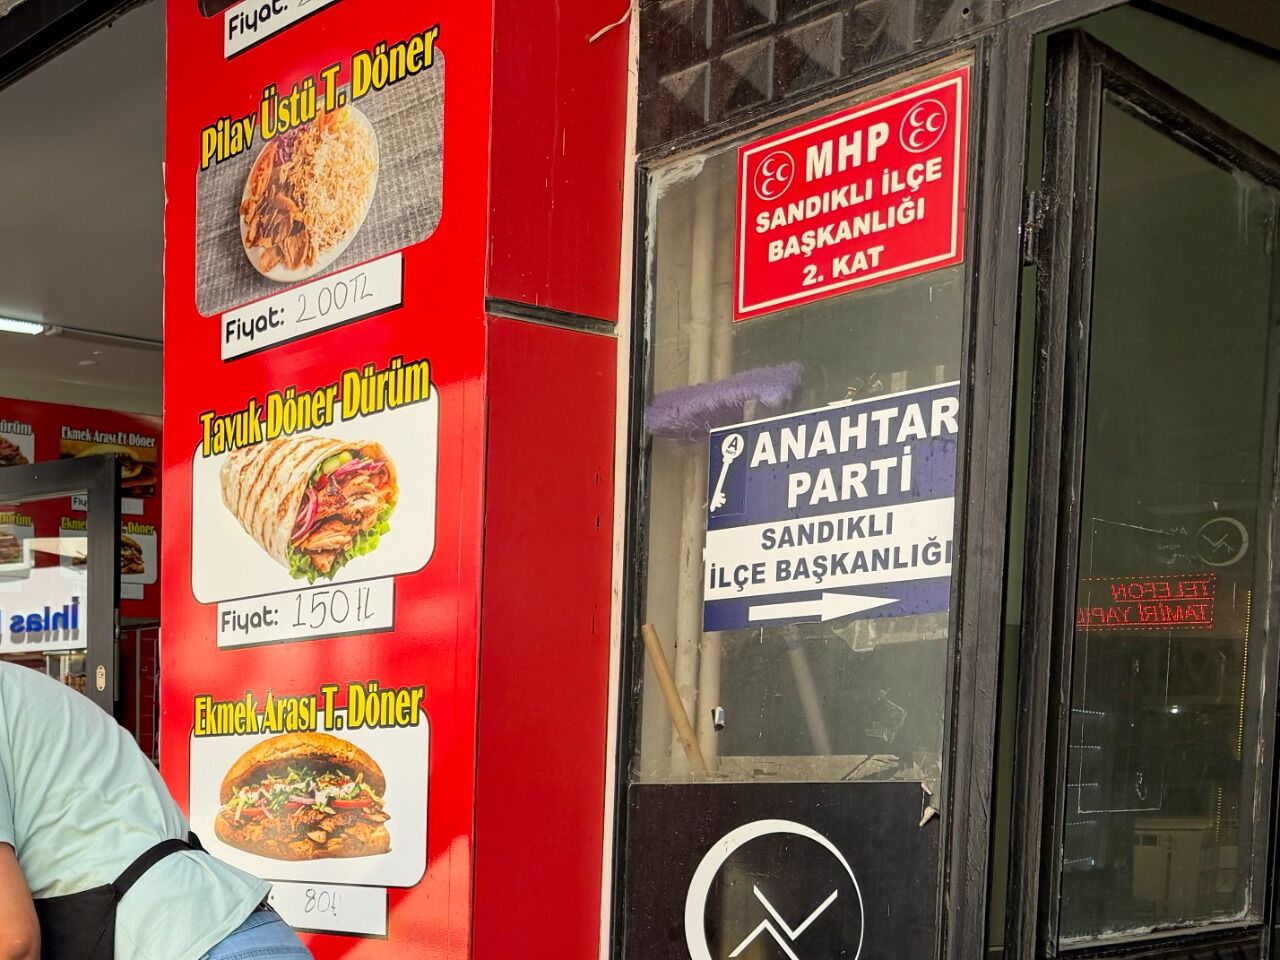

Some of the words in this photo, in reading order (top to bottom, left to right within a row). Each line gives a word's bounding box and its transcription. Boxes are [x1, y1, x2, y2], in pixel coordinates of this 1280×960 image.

[201, 112, 256, 170] Pilav
[260, 77, 317, 140] Üstü
[322, 65, 346, 112] T.
[351, 25, 439, 101] Döner
[806, 122, 889, 182] MHP
[756, 179, 872, 233] SANDIKLI
[882, 157, 942, 195] İLÇE
[768, 197, 925, 262] BAŞKANLIĞI
[802, 264, 823, 286] 2.
[832, 246, 884, 278] KAT
[225, 306, 285, 343] Fiyat:
[200, 399, 263, 457] Tavuk
[266, 386, 337, 440] Döner
[341, 356, 431, 418] Dürüm
[750, 396, 959, 468] ANAHTAR
[61, 425, 92, 442] Ekmek
[129, 434, 156, 448] Döner
[787, 446, 912, 508] PARTİ
[761, 512, 893, 550] SANDIKLI
[710, 562, 766, 592] İLÇE
[775, 536, 952, 583] BAŞKANLIĞI
[221, 606, 278, 634] Fiyat:
[194, 693, 258, 736] Ekmek
[261, 690, 317, 732] Arası
[321, 685, 342, 729] T.
[347, 682, 424, 728] Döner
